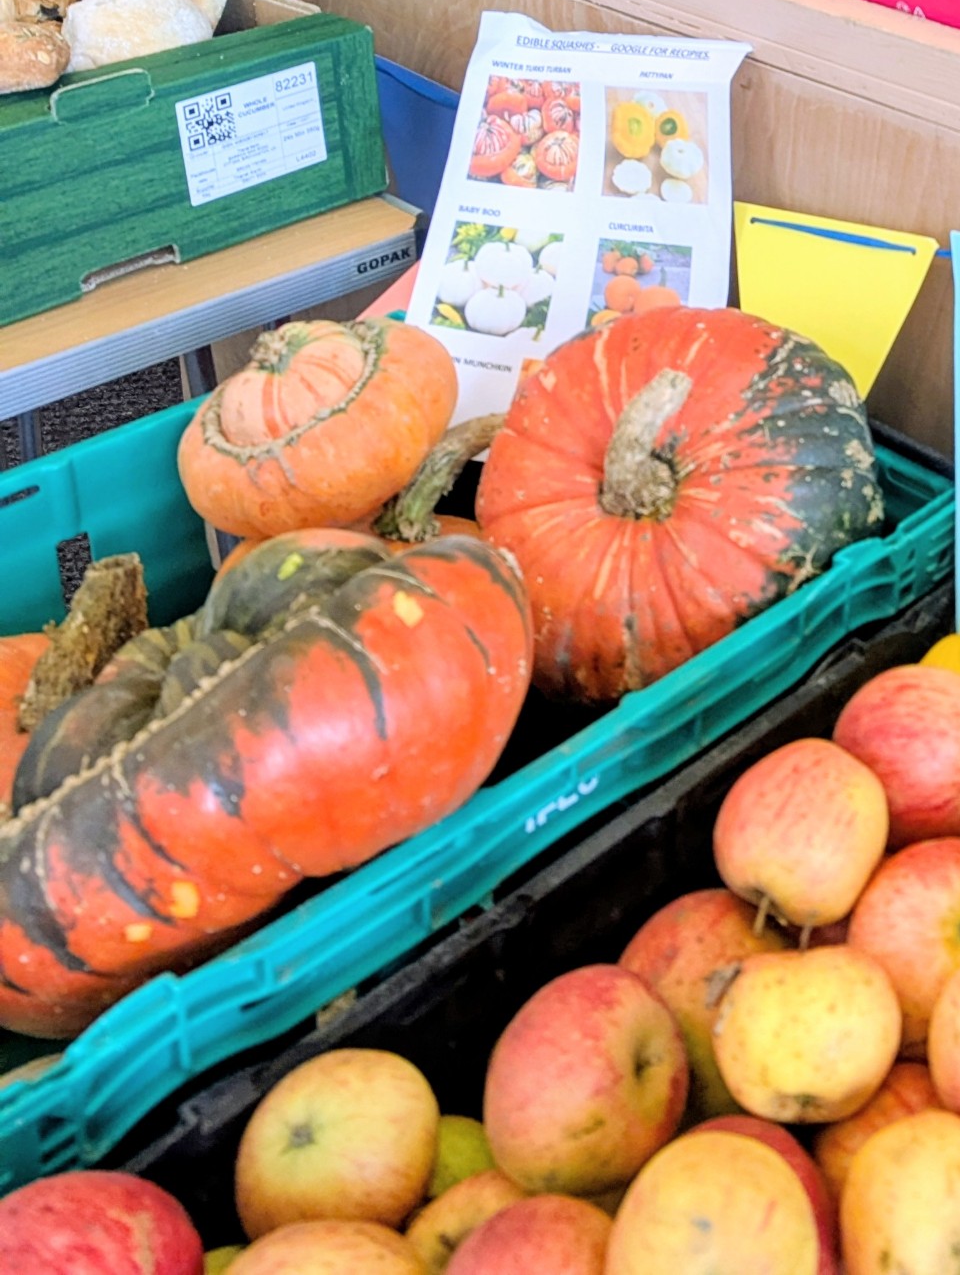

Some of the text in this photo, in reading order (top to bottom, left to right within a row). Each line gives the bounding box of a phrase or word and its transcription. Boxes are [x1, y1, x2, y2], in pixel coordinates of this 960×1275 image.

[516, 35, 550, 49] EDIBLE
[550, 40, 595, 52] SQUASHES
[610, 43, 649, 55] GOOGLE
[649, 46, 667, 56] FOR
[491, 60, 524, 72] WINTER
[545, 65, 572, 75] TURBAN
[275, 71, 313, 93] 82231
[458, 205, 501, 218] BABY BOO
[357, 247, 411, 274] GOPAK
